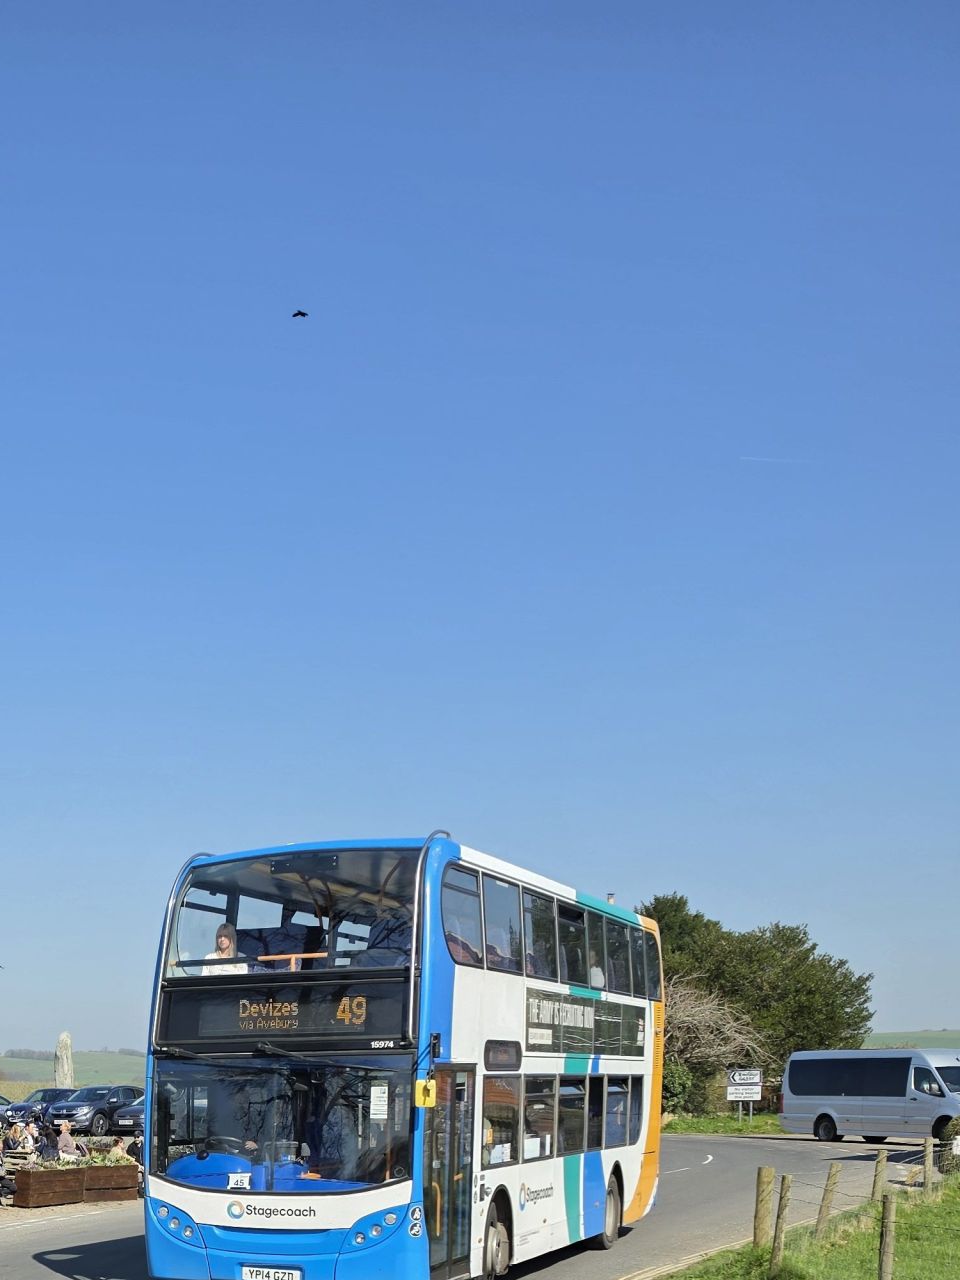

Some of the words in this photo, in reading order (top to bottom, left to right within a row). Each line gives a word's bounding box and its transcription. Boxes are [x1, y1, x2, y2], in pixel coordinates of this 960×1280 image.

[239, 998, 298, 1018] Devizes
[336, 996, 366, 1025] 49
[239, 1020, 254, 1030] via
[257, 1018, 298, 1030] Avebury
[370, 1040, 394, 1049] 15974
[526, 1182, 554, 1205] Stagecoach
[245, 1204, 316, 1218] Stagecoach
[249, 1269, 271, 1280] YP14
